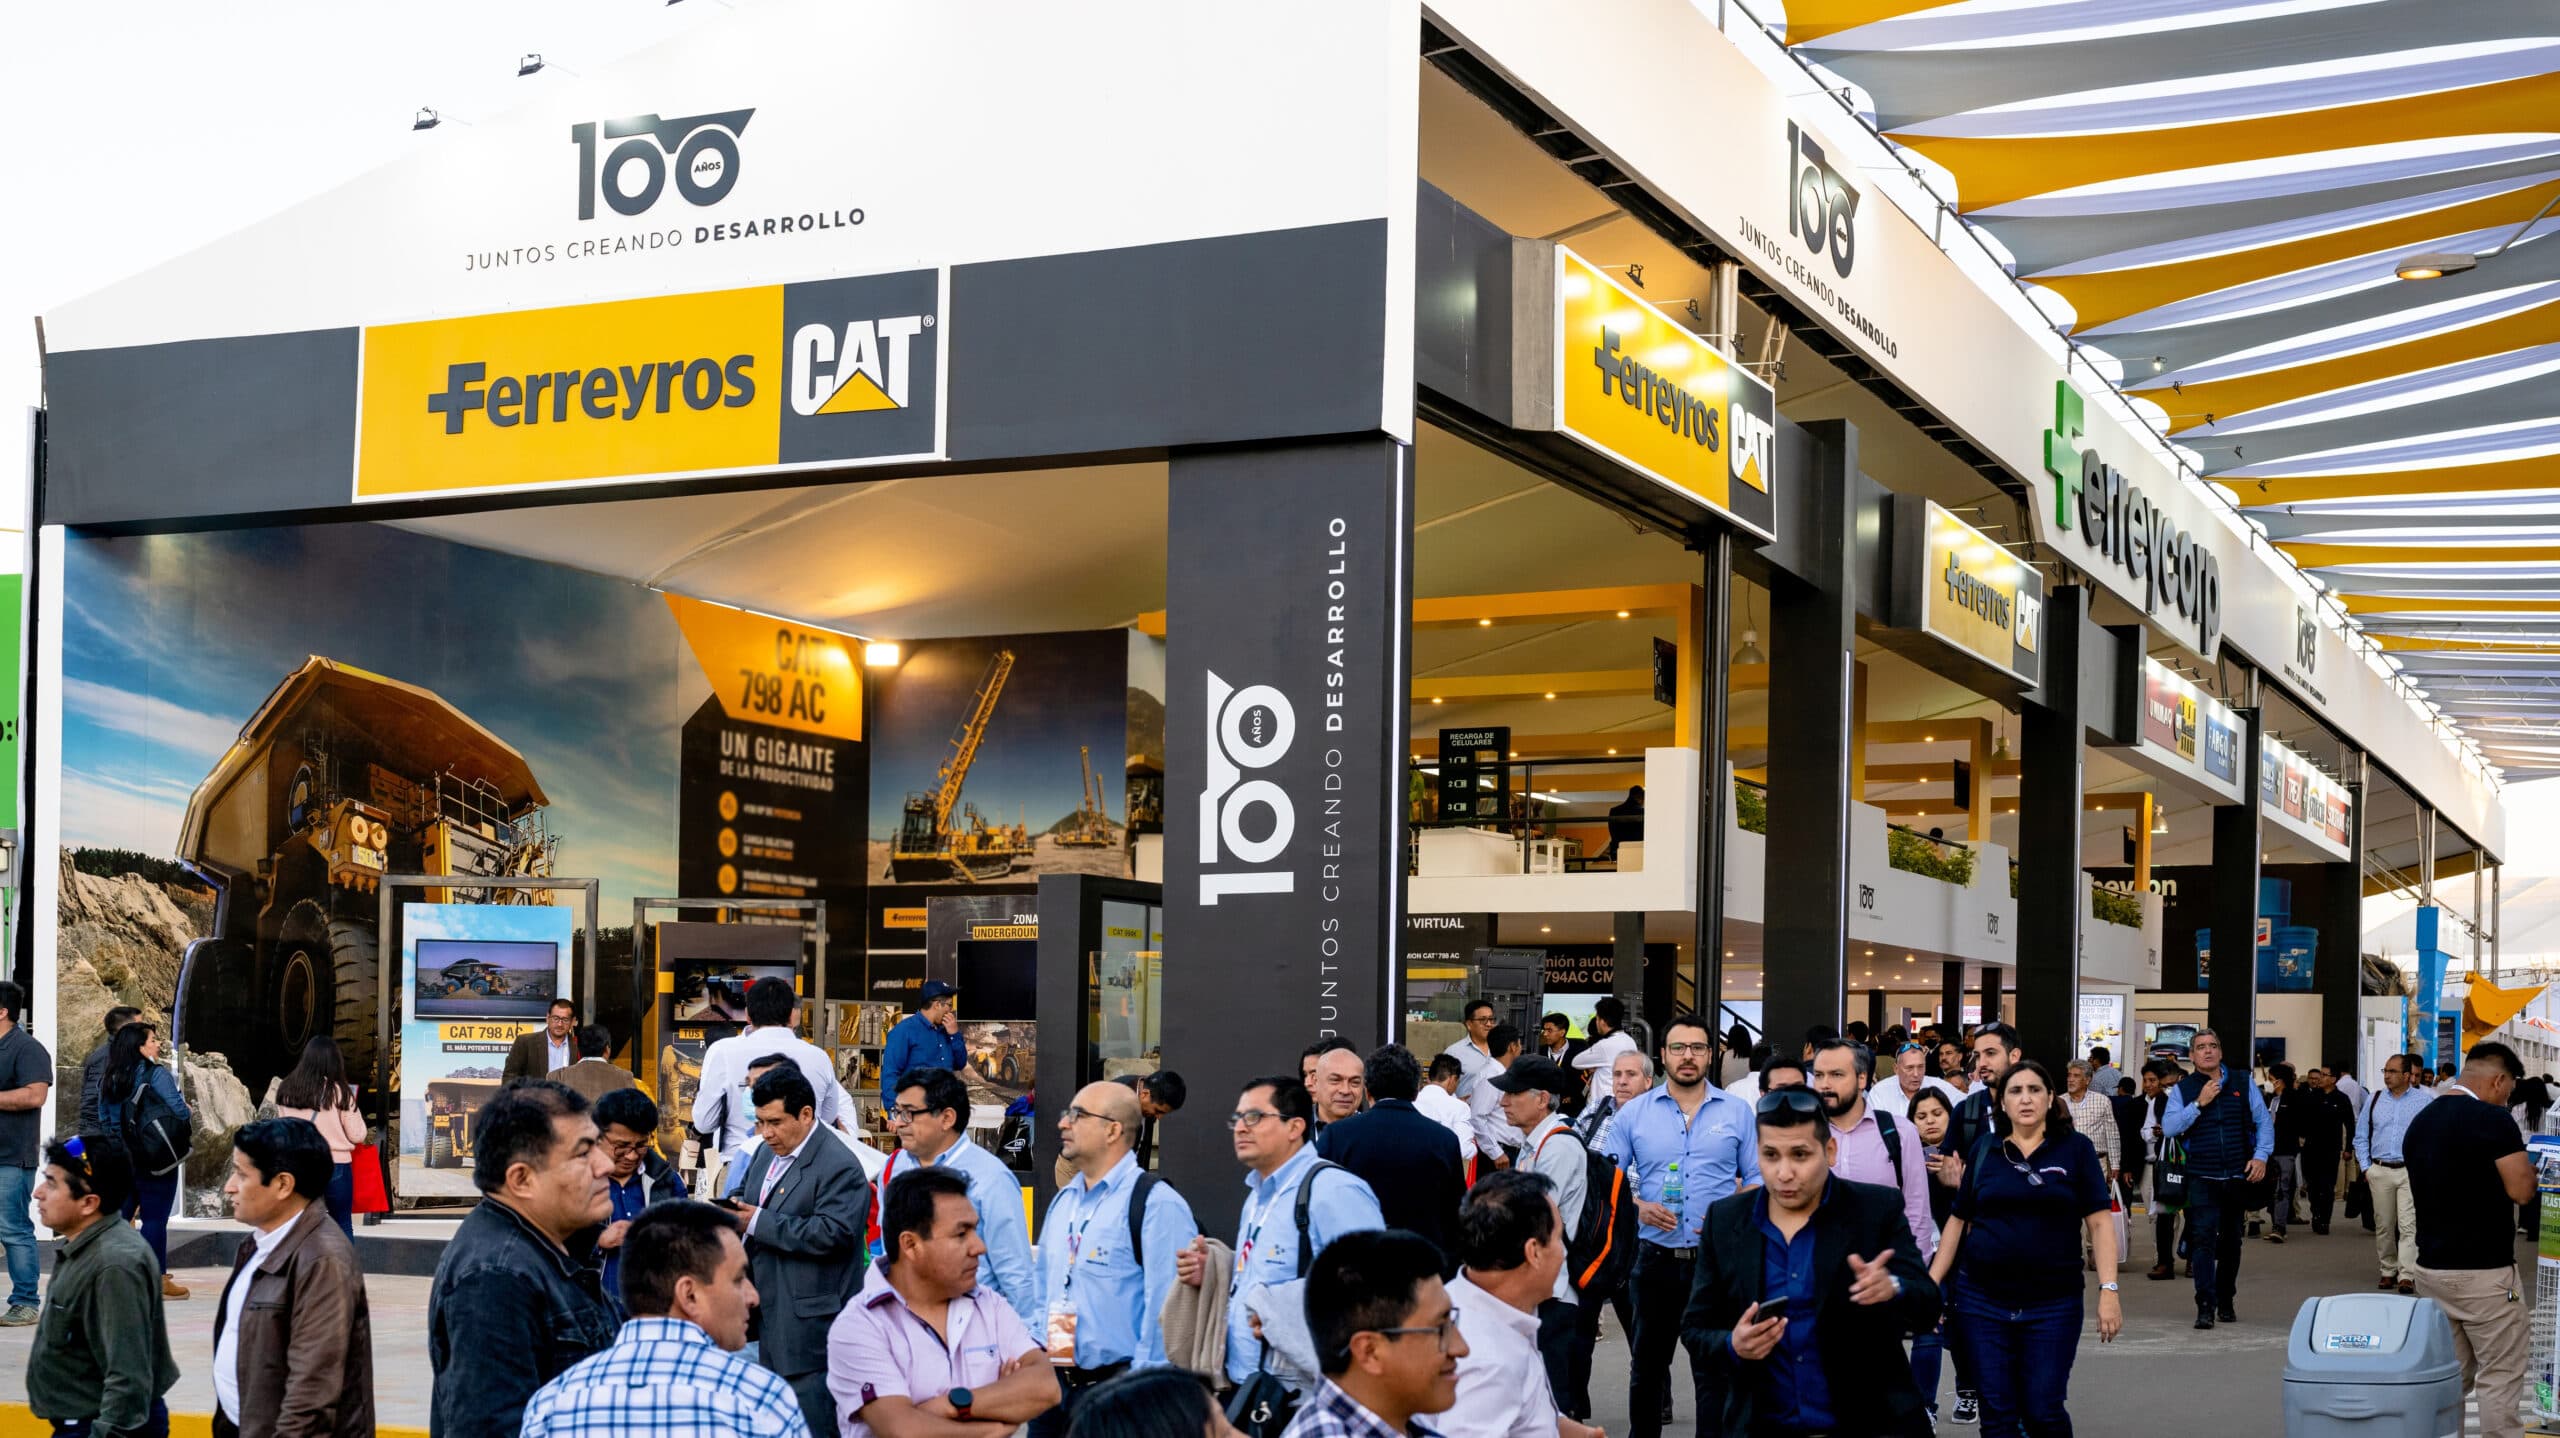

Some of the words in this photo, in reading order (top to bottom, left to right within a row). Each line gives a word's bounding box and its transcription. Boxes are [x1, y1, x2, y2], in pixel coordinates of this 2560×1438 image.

[572, 108, 756, 221] 100
[694, 161, 721, 173] AÑOS
[465, 244, 556, 272] JUNTOS
[566, 229, 684, 260] CREANDO
[694, 207, 866, 244] DESARROLLO
[1739, 215, 1783, 266] JUNTOS
[1785, 255, 1835, 307] CREANDO
[1837, 296, 1898, 359] DESARROLLO
[428, 354, 756, 435] Ferreyros
[1594, 324, 1719, 453] Ferreyros
[1731, 402, 1774, 494] CAT
[2043, 380, 2221, 656] Ferreycorp
[1945, 551, 2010, 630] Ferreyros
[1326, 517, 1347, 732] DESARROLLO
[2016, 589, 2041, 654] CAT
[776, 628, 826, 677] CAT
[739, 667, 783, 715] 798
[788, 679, 826, 724] AC
[1253, 709, 1263, 744] AÑOS
[1451, 739, 1493, 747] CELULARES
[2207, 725, 2229, 758] FARGO
[720, 729, 748, 758] UN
[755, 736, 835, 774] GIGANTE
[720, 759, 734, 775] DE
[736, 762, 750, 778] LA
[752, 765, 834, 792] PRODUCTIVIDAD
[1322, 748, 1343, 902] CREANDO
[974, 927, 1037, 938] UNDERGROUN
[1012, 914, 1039, 925] ZONA
[1412, 917, 1465, 929] VIRTUAL
[904, 978, 923, 989] QUE
[1319, 917, 1340, 1038] JUNTOS
[449, 1025, 474, 1039] CAT
[478, 1026, 503, 1039] 798
[683, 1029, 700, 1038] TUS
[2167, 1172, 2184, 1184] CAT
